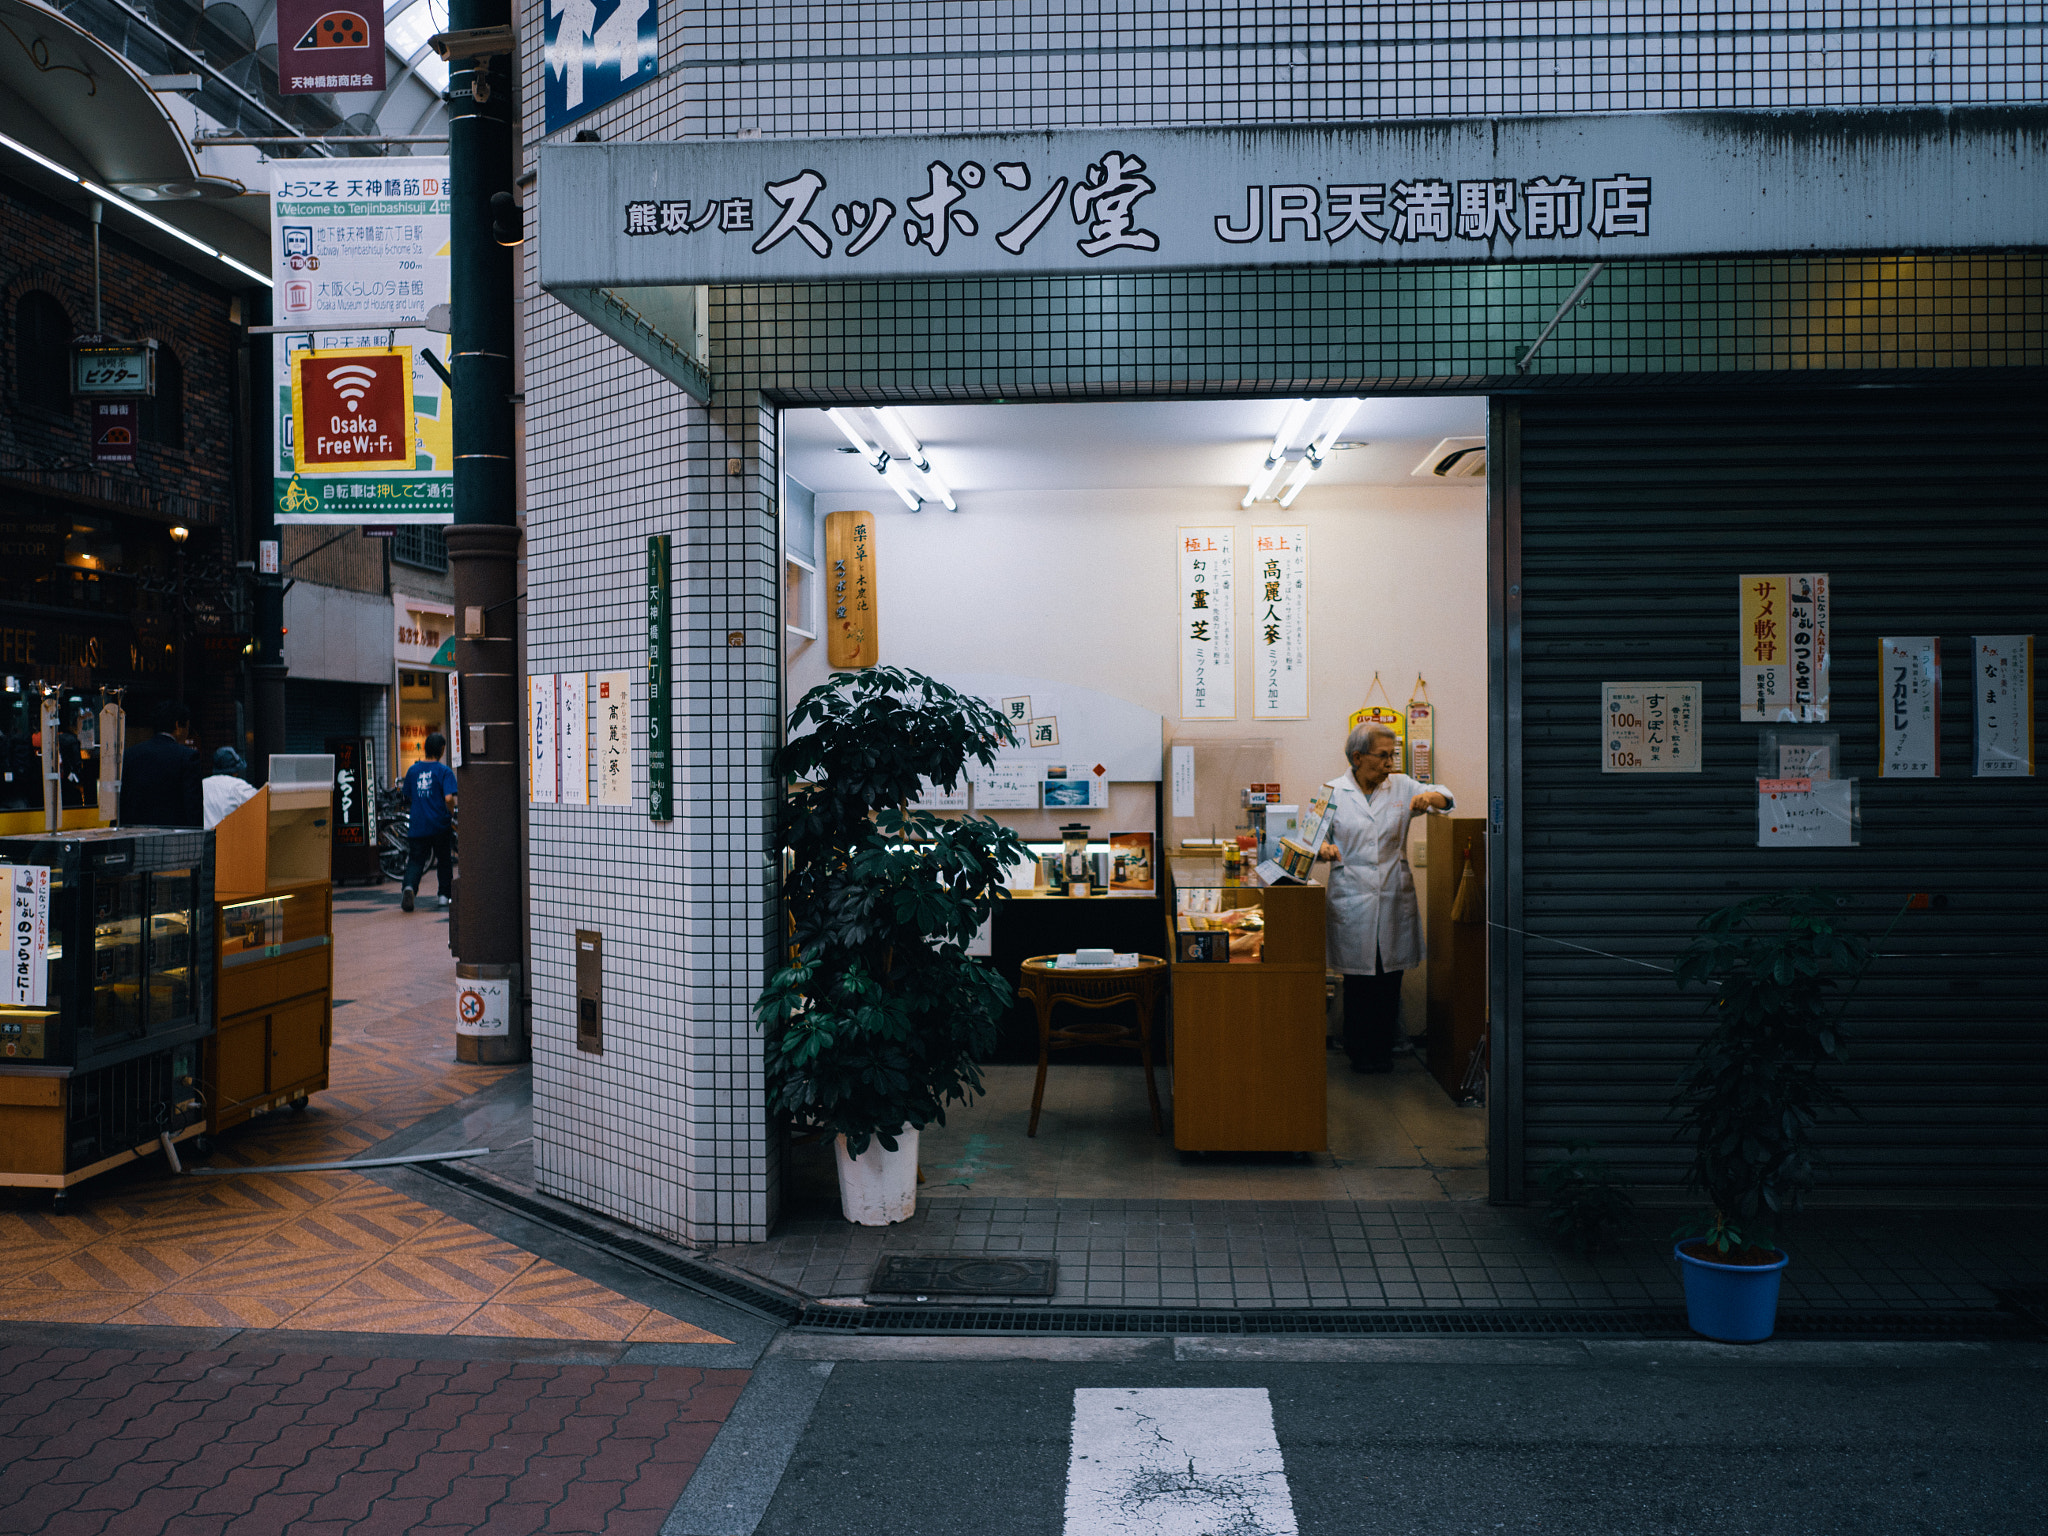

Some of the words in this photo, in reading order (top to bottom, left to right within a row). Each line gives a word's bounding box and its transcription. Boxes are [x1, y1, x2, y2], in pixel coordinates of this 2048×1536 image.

[291, 74, 374, 89] 天神橋筋商店会
[277, 180, 339, 198] ようこそ
[278, 203, 330, 215] Welcome
[333, 202, 345, 214] to
[348, 201, 426, 216] Tenjinbashisuji
[625, 198, 753, 236] 熊坂ノ庄
[753, 150, 1160, 258] スッポン堂
[1214, 173, 1652, 244] JR天満駅前店
[317, 225, 423, 243] 地下鉄天神橋筋六丁目駅
[317, 244, 340, 257] Subway
[317, 280, 424, 297] 大阪くらしの今昔館
[317, 299, 336, 311] Osaka
[337, 299, 362, 311] Museum
[363, 298, 370, 310] of
[370, 298, 394, 312] Housing
[395, 298, 407, 310] and
[86, 368, 139, 385] ビクター
[331, 414, 377, 434] Osaka
[317, 436, 351, 455] Free
[352, 434, 392, 454] Wi-Fi
[323, 483, 453, 499] 自転車は押してご通行
[1184, 537, 1218, 553] 極上
[1257, 536, 1290, 552] 極上
[834, 558, 848, 620] スッポン堂
[1753, 581, 1777, 662] サメ軟骨
[1892, 666, 1909, 732] フカヒレ
[1984, 663, 1998, 729] なまこ
[1009, 701, 1026, 720] 男
[650, 717, 659, 739] 5
[1610, 713, 1642, 728] 100円
[1035, 724, 1053, 743] 酒
[1610, 751, 1642, 767] 103円
